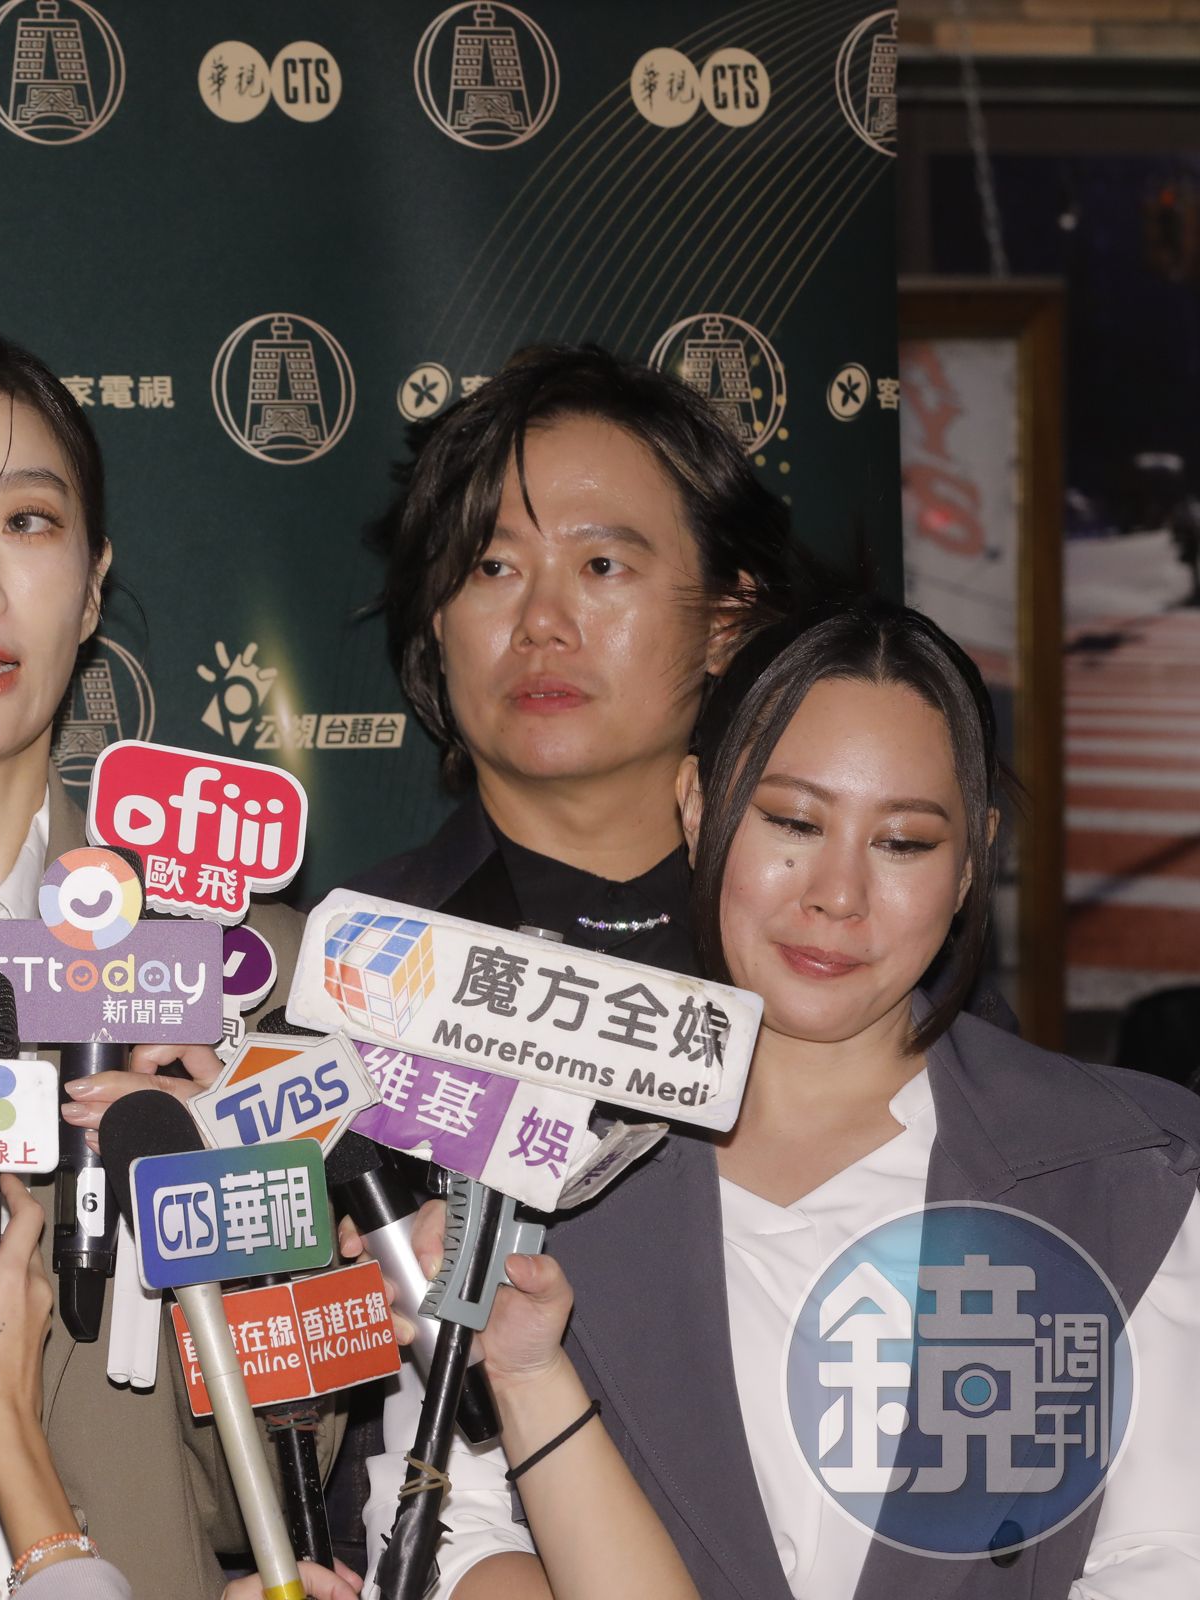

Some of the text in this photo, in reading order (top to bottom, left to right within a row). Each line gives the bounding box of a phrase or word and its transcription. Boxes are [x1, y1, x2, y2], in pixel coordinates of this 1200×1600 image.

[207, 54, 330, 106] 華視 CTS
[639, 62, 760, 112] 華視 CTS
[113, 766, 284, 870] ofiii
[145, 854, 238, 905] 歐飛
[102, 998, 185, 1025] 新聞雲
[432, 1019, 615, 1087] MoreForms
[215, 1059, 350, 1146] TVBS
[82, 1193, 98, 1214] 6
[158, 1166, 318, 1255] CTS 華視
[301, 1291, 389, 1342] 香港在線
[309, 1328, 394, 1365] HKOnline
